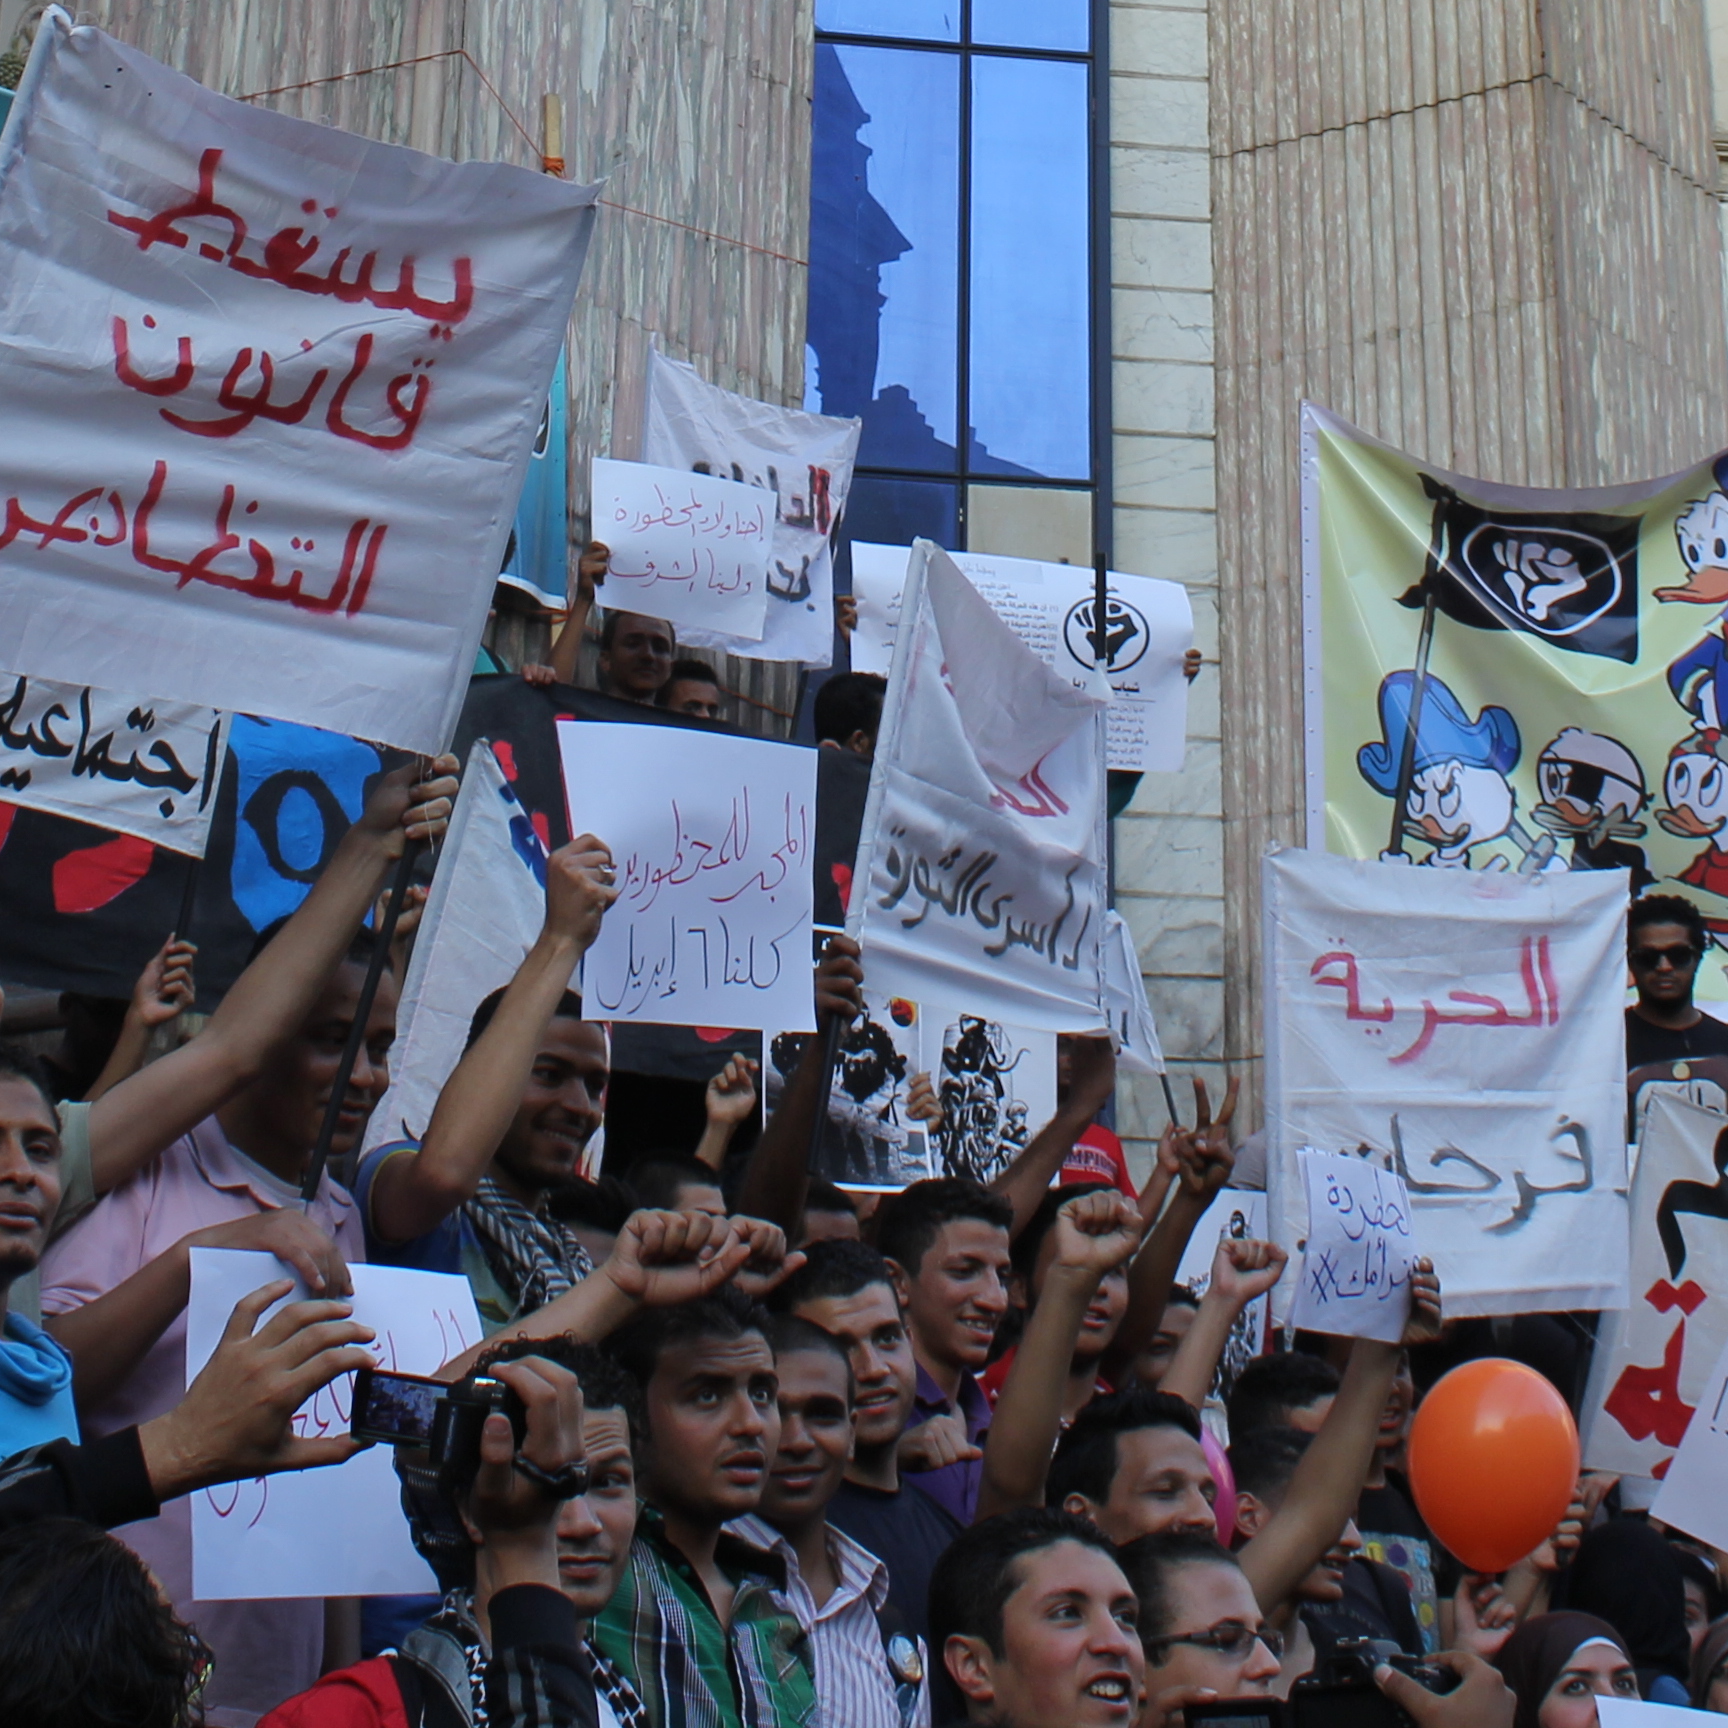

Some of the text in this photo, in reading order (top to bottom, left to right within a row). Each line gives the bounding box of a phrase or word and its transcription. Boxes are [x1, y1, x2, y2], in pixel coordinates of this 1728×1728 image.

[107, 147, 475, 344] يسقط
[111, 312, 433, 453] قانون
[719, 908, 810, 990] كلنا
[1309, 935, 1561, 1066] الحرية
